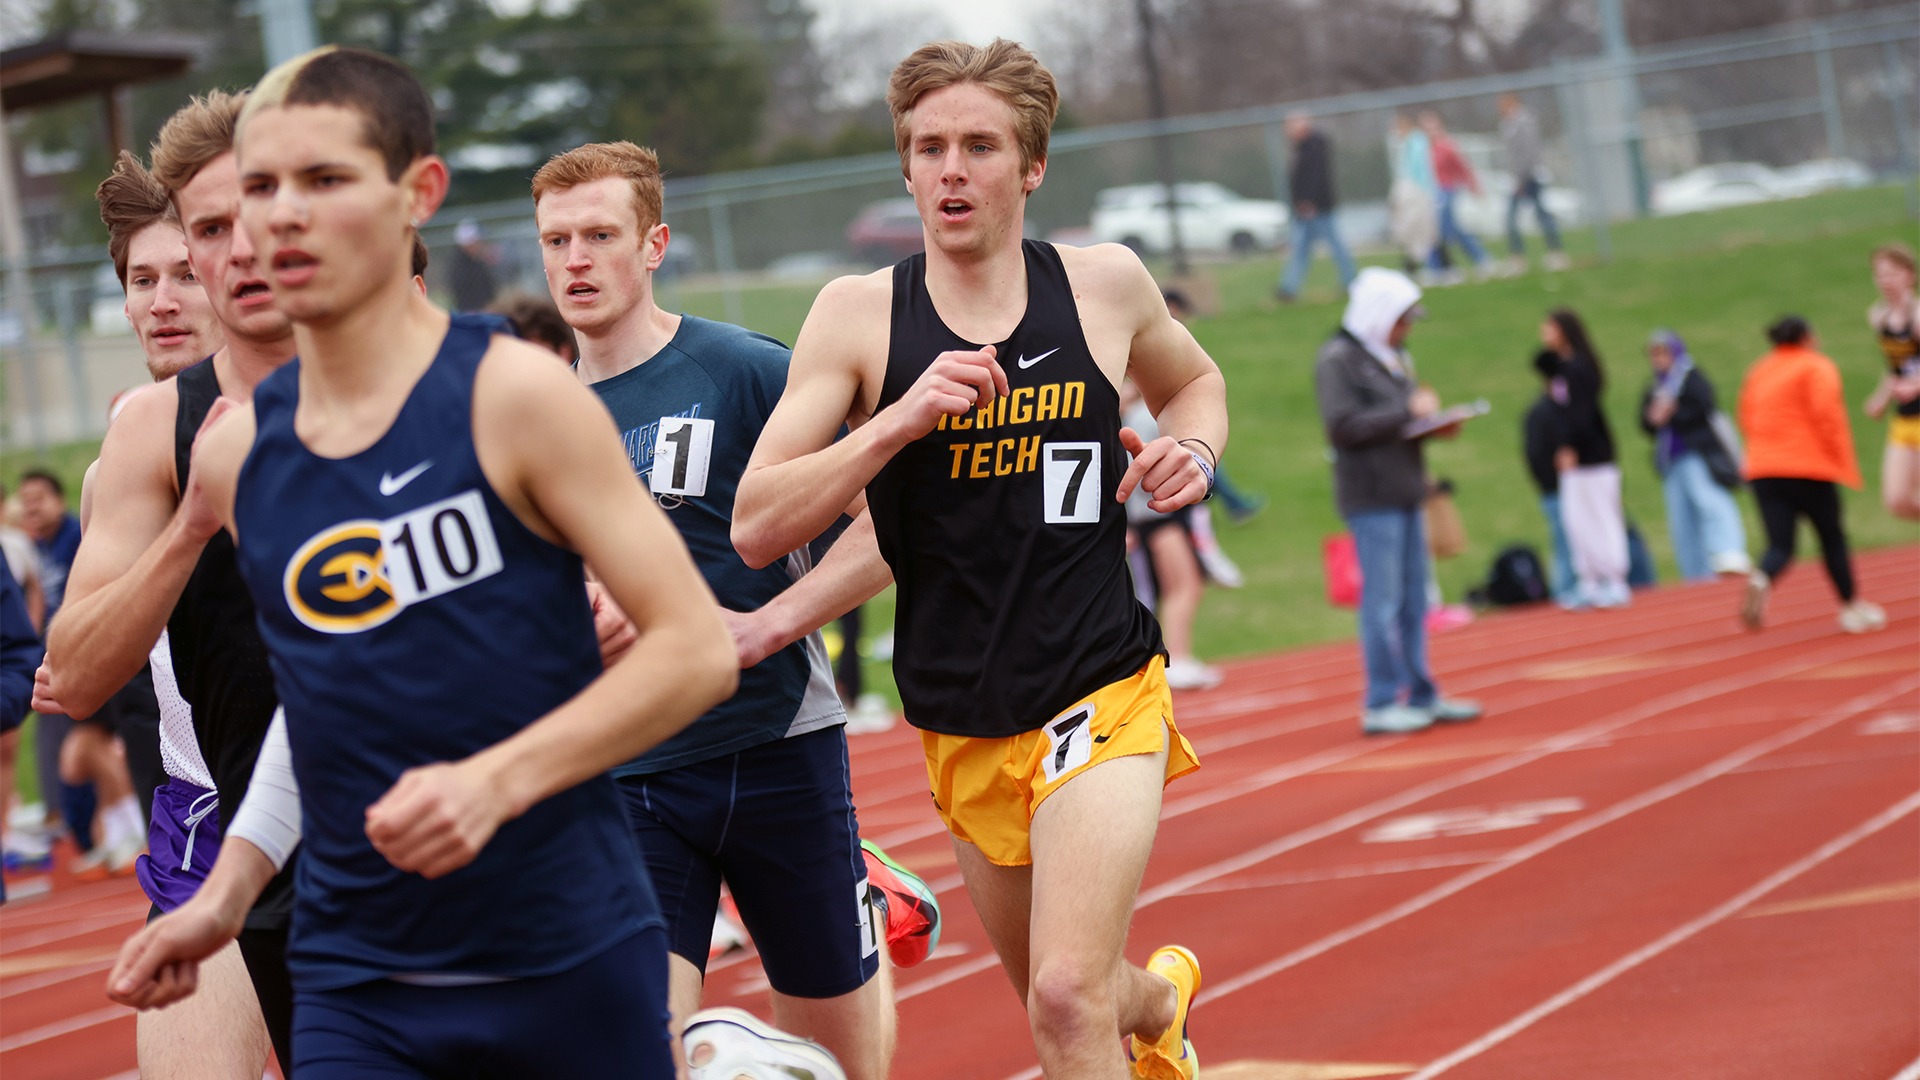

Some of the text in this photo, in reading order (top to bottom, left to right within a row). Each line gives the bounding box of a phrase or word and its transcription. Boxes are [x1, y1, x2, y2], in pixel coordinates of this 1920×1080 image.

[937, 381, 1086, 431] CHIGAN
[664, 423, 693, 490] 1
[949, 434, 1041, 479] TECH
[1051, 448, 1093, 517] 7
[391, 508, 479, 593] 10
[1051, 709, 1089, 774] 7
[861, 881, 877, 948] 1
